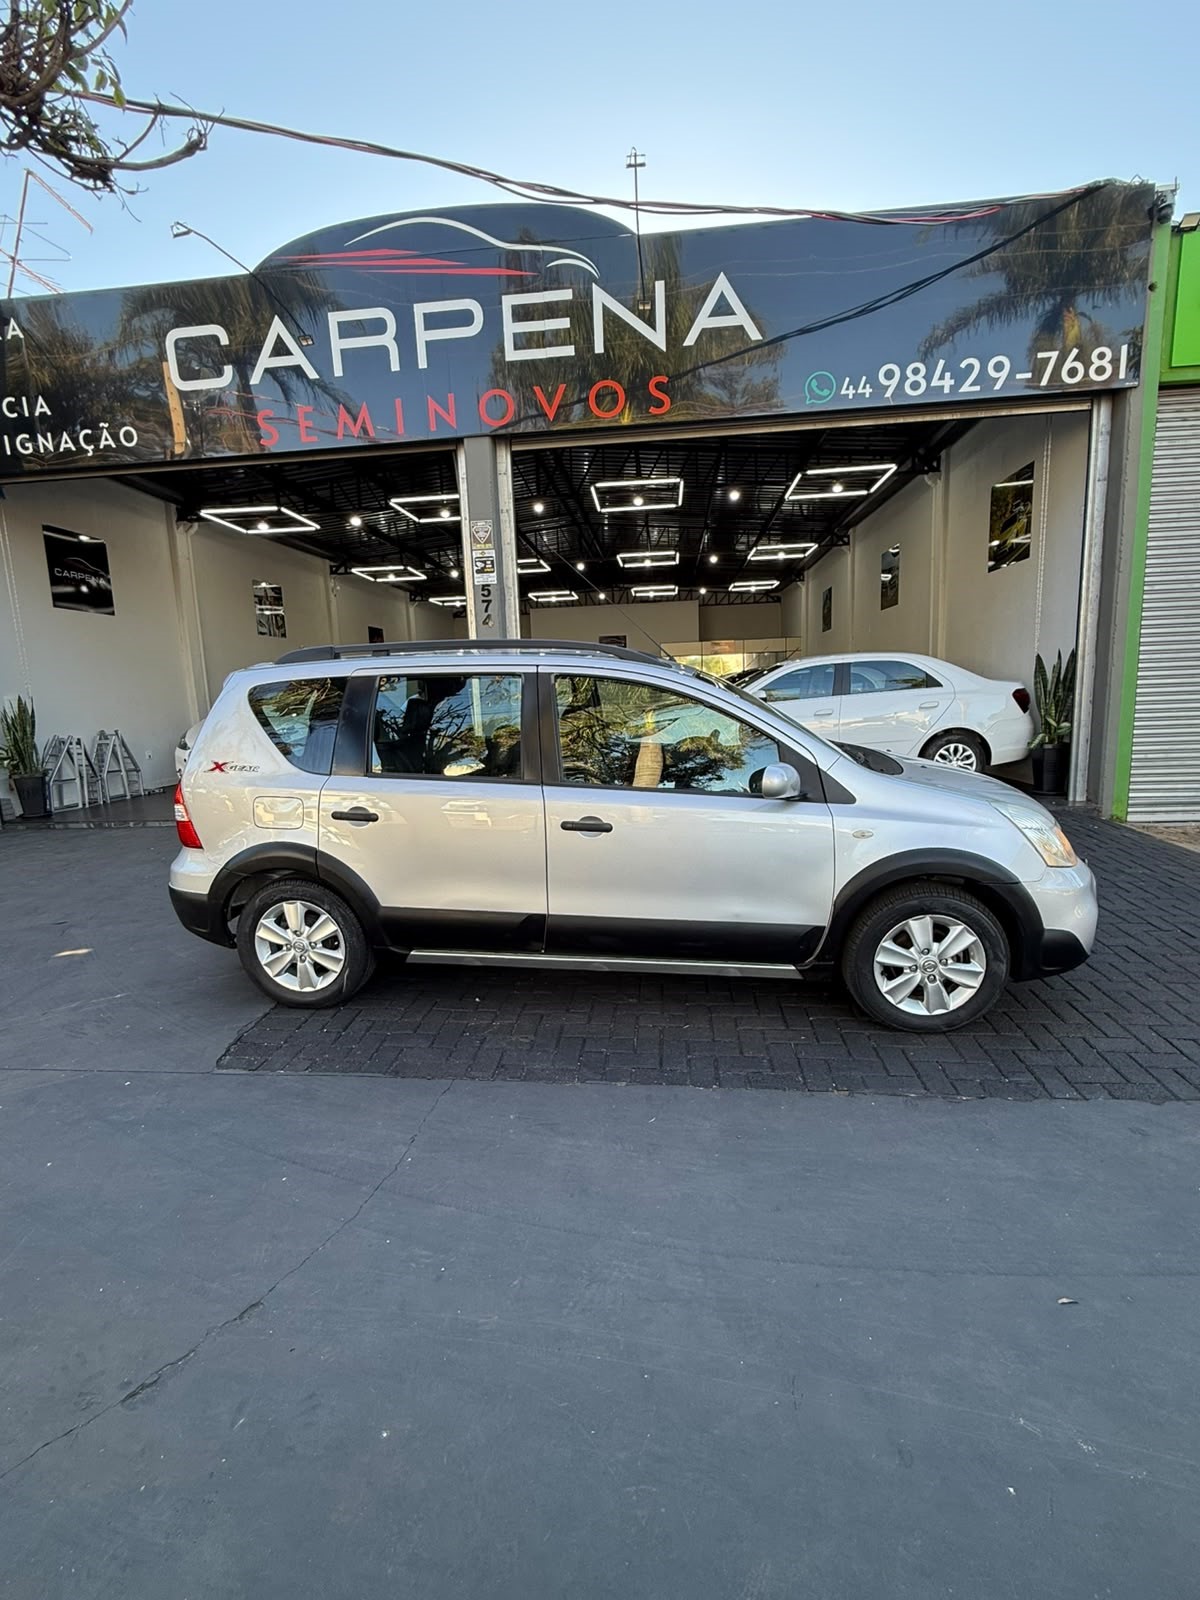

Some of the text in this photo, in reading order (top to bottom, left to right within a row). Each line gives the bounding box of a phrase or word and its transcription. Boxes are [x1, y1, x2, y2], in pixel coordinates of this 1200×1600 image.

[0, 317, 24, 341] A
[164, 270, 763, 392] CARPENA
[840, 344, 1128, 399] 44 98429-7681
[1, 395, 52, 418] CIA
[257, 375, 672, 446] SEMINOVOS
[3, 422, 138, 456] IGNAÇÃO
[54, 567, 106, 584] CARPENA
